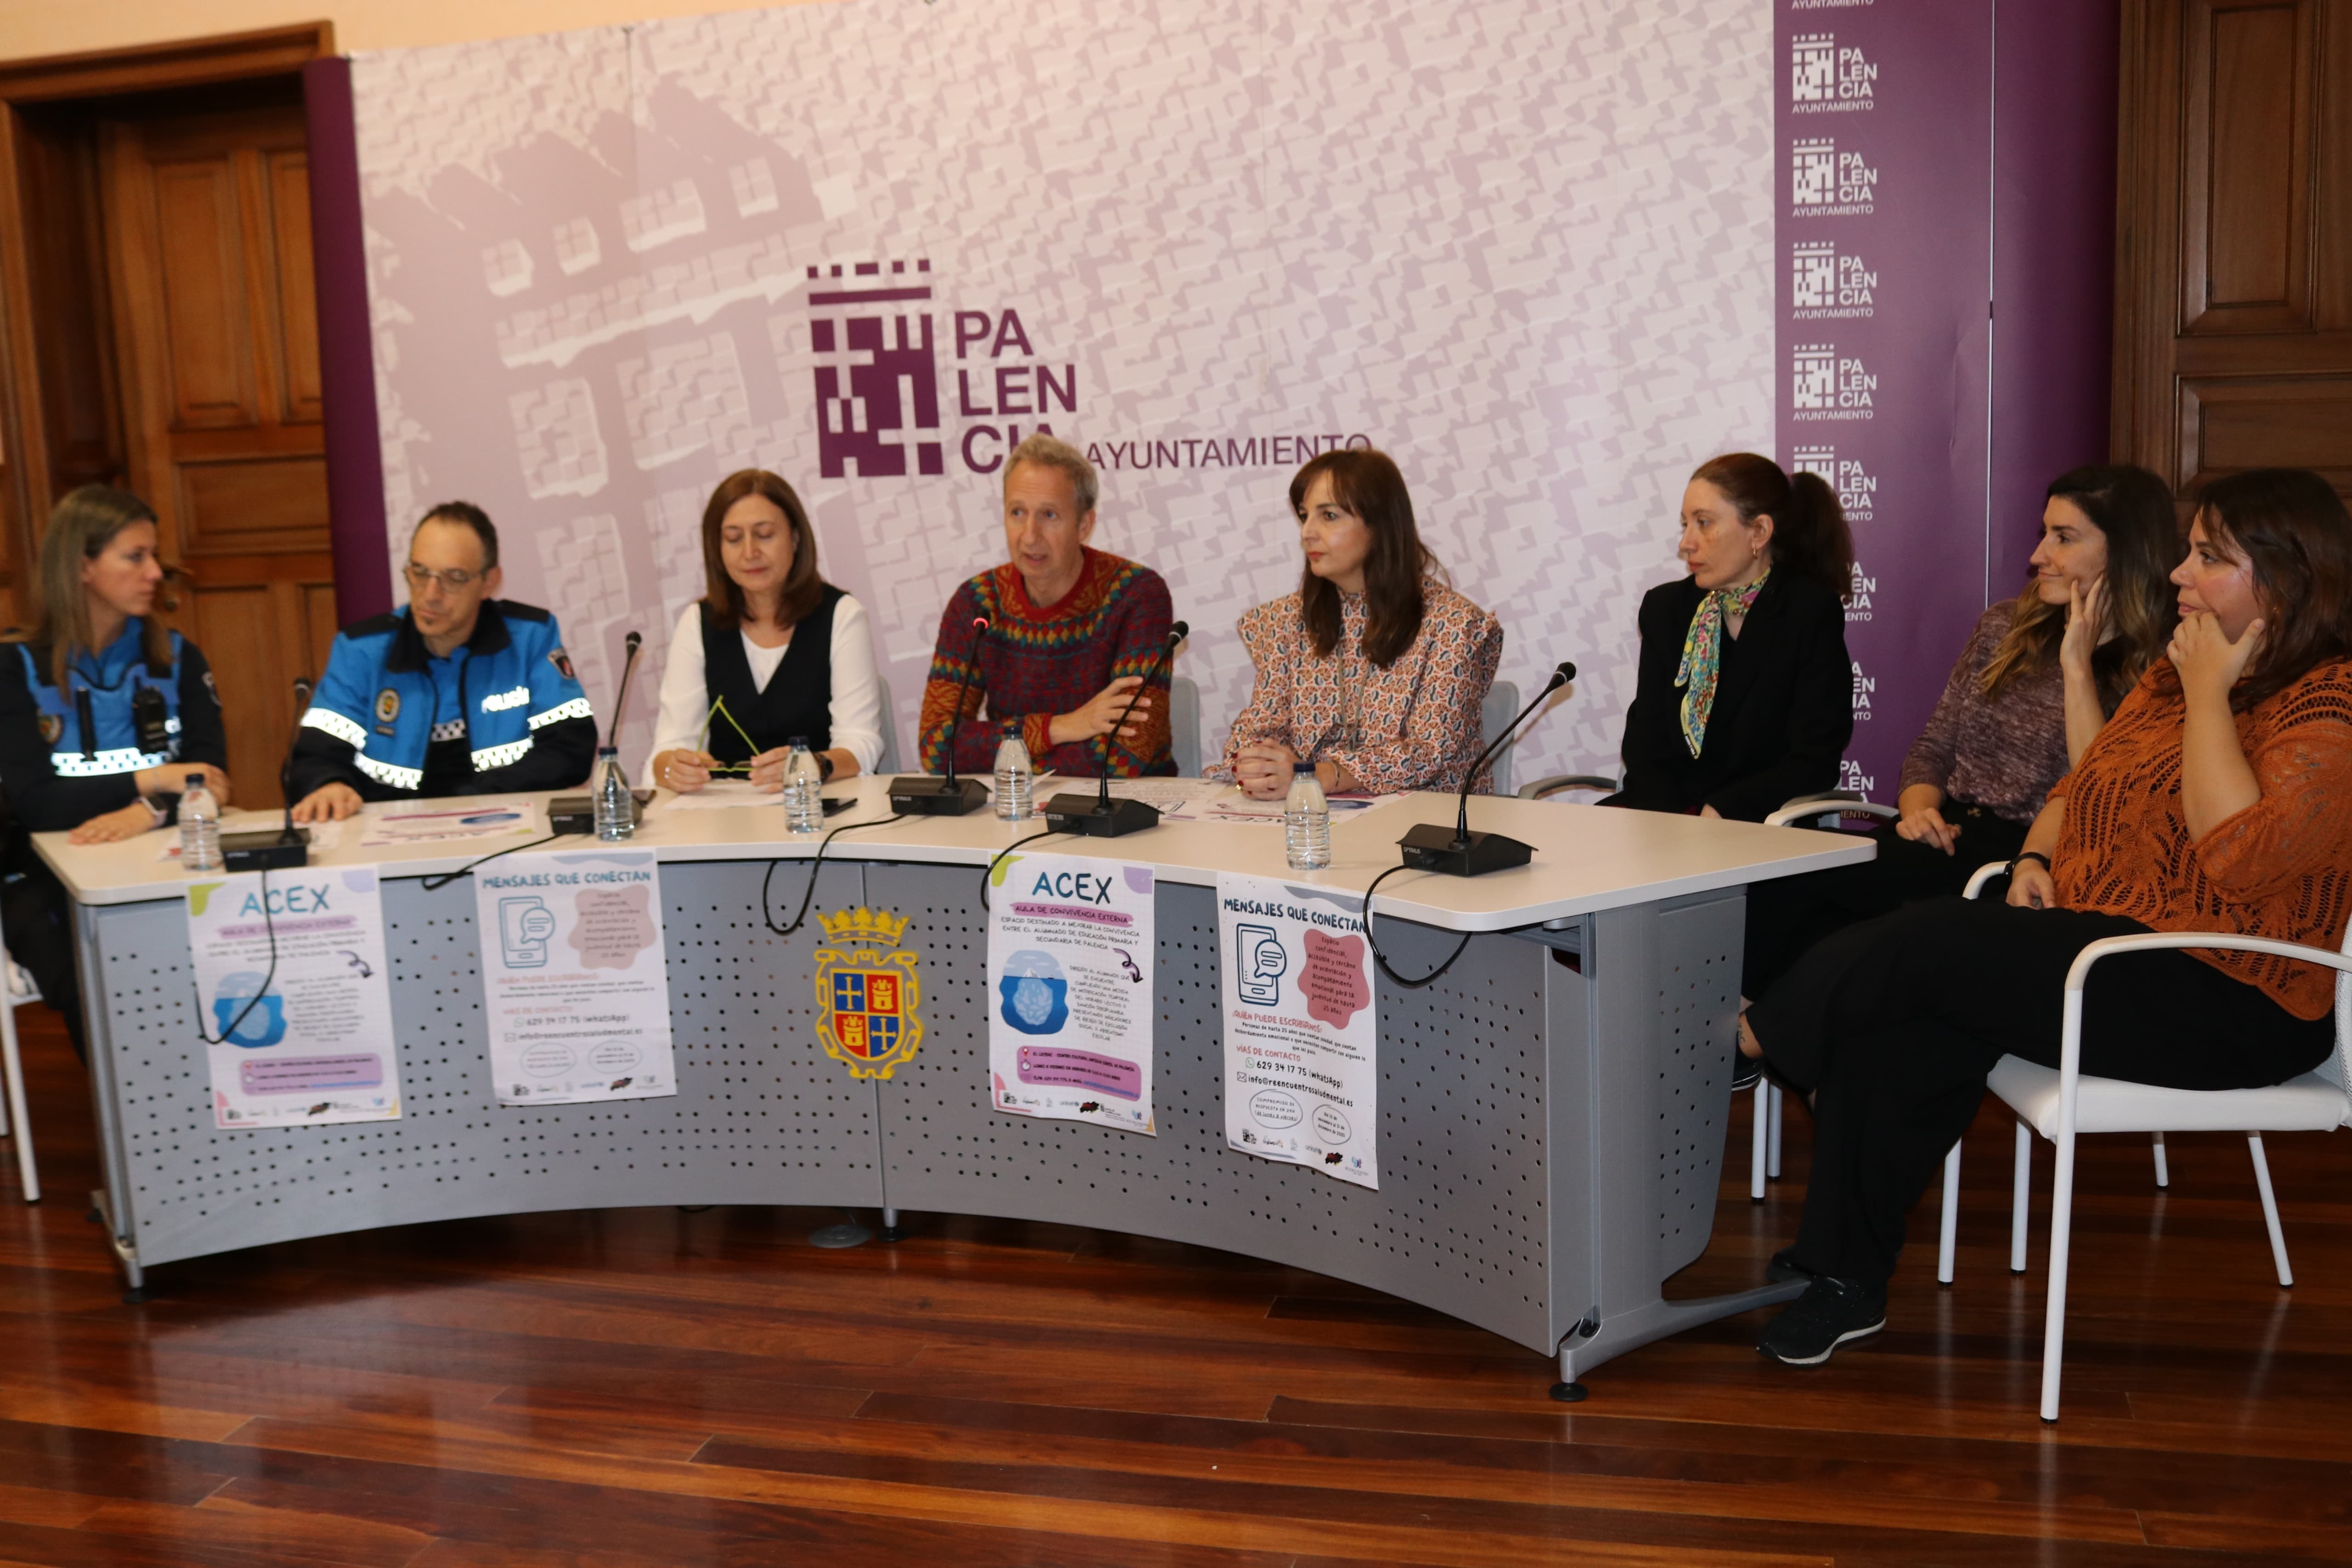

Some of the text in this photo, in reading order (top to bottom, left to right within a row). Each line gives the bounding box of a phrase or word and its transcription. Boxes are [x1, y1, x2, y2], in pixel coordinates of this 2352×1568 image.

[1839, 48, 1865, 64] PA
[1839, 63, 1877, 81] LEN
[1839, 81, 1873, 98] CIA
[1792, 101, 1874, 114] AYUNTAMIENTO
[1839, 152, 1865, 169] PA
[1839, 168, 1877, 185] LEN
[1839, 186, 1873, 203] CIA
[1792, 204, 1874, 217] AYUNTAMIENTO
[1839, 255, 1865, 272] PA
[1839, 272, 1877, 289] LEN
[1839, 289, 1873, 306] CIA
[1792, 307, 1874, 320] AYUNTAMIENTO
[955, 309, 1034, 359] PA
[1839, 358, 1865, 374] PA
[958, 364, 1077, 417] LEN
[1839, 374, 1877, 391] LEN
[1839, 391, 1873, 407] CIA
[1792, 410, 1874, 421] AYUNTAMIENTO
[961, 423, 1054, 474] CI
[1839, 460, 1864, 476] PA
[1839, 476, 1876, 492] LEN
[1839, 493, 1872, 509] CIA
[1847, 561, 1863, 577] A
[1851, 577, 1876, 593] EN
[1853, 678, 1875, 692] EN
[1852, 694, 1871, 708] IA
[1840, 776, 1874, 791] LEN
[483, 871, 651, 889] MENSAJES QUE CONECTAN
[1032, 872, 1112, 905] ACEX
[239, 884, 330, 917] ACEX
[1050, 908, 1096, 918] CONVIVENCIA
[1098, 914, 1128, 923] EXTERNA
[1224, 899, 1366, 933] MENSAJES QUE CONECTAN
[1322, 937, 1339, 945] Espacio
[1340, 1000, 1355, 1008] hasta
[1255, 1013, 1278, 1024] PUEDE
[1253, 1047, 1262, 1056] DE
[1265, 1049, 1300, 1061] CONTACTO
[1257, 1061, 1272, 1070] 629
[1275, 1063, 1284, 1071] 34
[1288, 1065, 1295, 1073] 17
[1298, 1067, 1307, 1076] 75
[1249, 1075, 1353, 1107] info@reencuentrosaludmental.es
